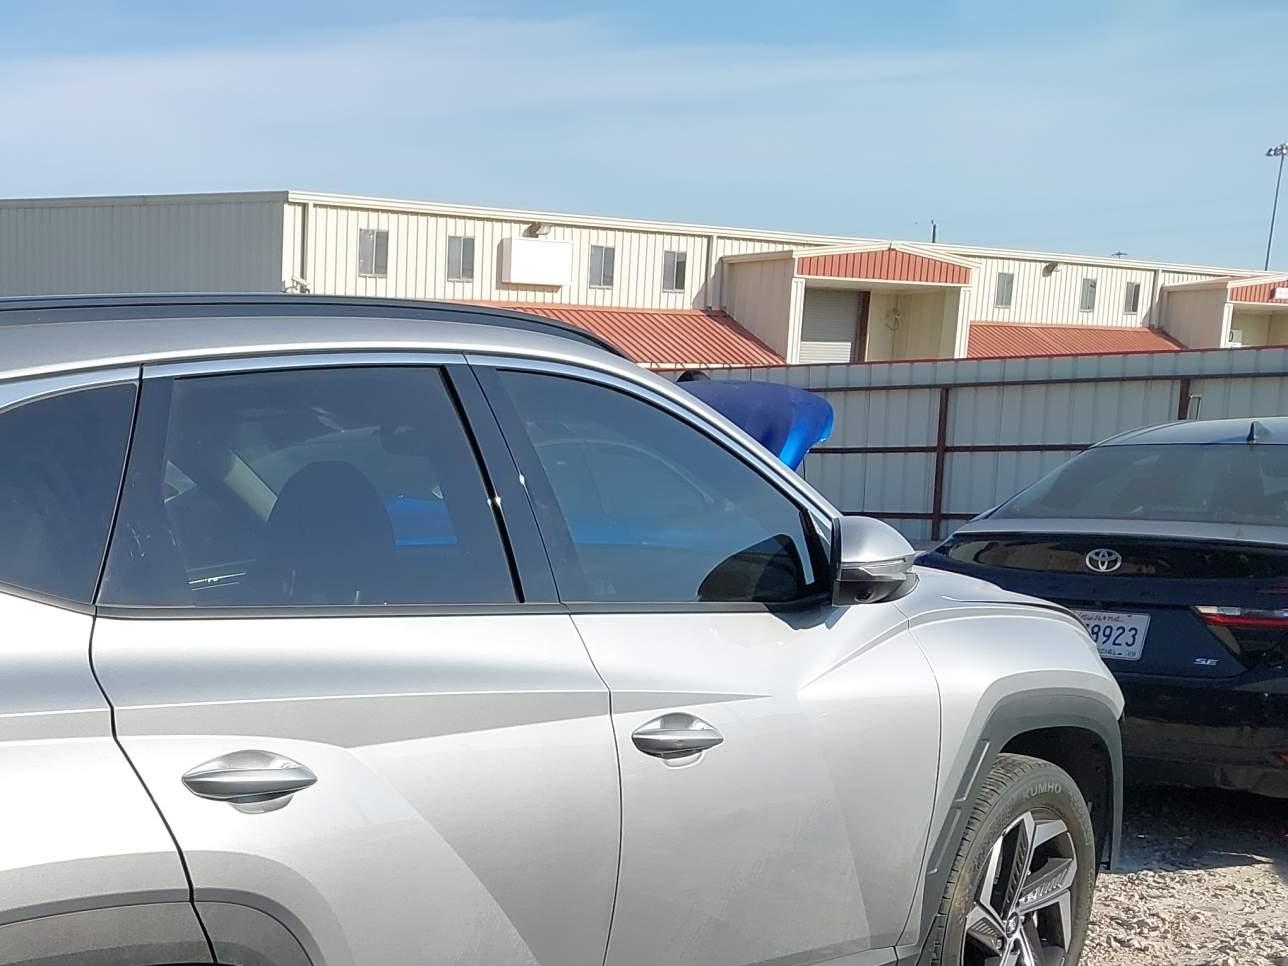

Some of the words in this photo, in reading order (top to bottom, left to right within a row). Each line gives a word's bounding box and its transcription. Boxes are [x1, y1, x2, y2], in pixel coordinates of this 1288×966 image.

[1086, 623, 1138, 647] 8923
[1193, 658, 1219, 666] SE
[1022, 782, 1063, 800] KUMHO
